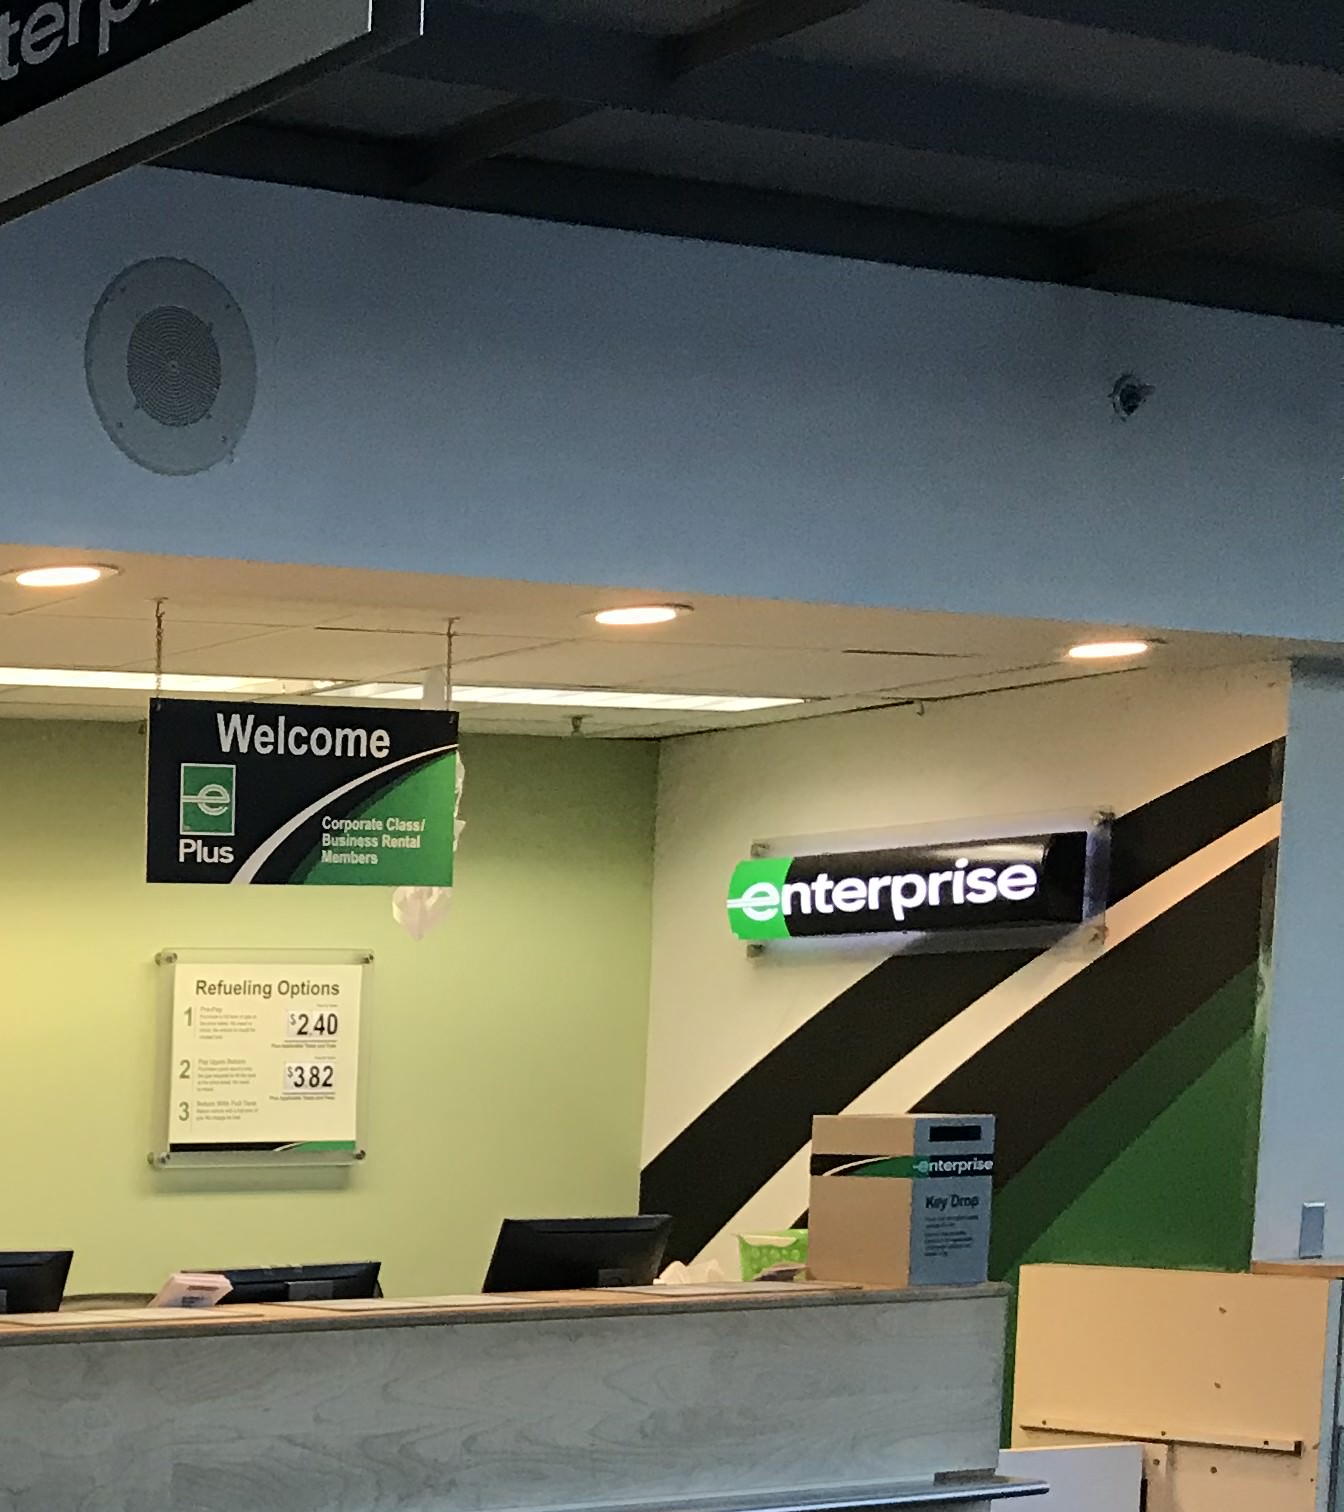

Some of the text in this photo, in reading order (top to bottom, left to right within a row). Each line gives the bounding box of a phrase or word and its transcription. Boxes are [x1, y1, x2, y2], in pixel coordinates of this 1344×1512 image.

[217, 712, 391, 758] Welcome
[322, 816, 383, 833] Corporate
[322, 833, 421, 848] Business Rental
[179, 839, 234, 863] Plus
[321, 850, 379, 864] Members
[727, 858, 1038, 922] enterprise
[195, 980, 340, 999] Refueling Options
[183, 1006, 193, 1027] 1
[179, 1059, 190, 1079] 2
[178, 1101, 190, 1122] 3
[913, 1157, 994, 1174] enterprise
